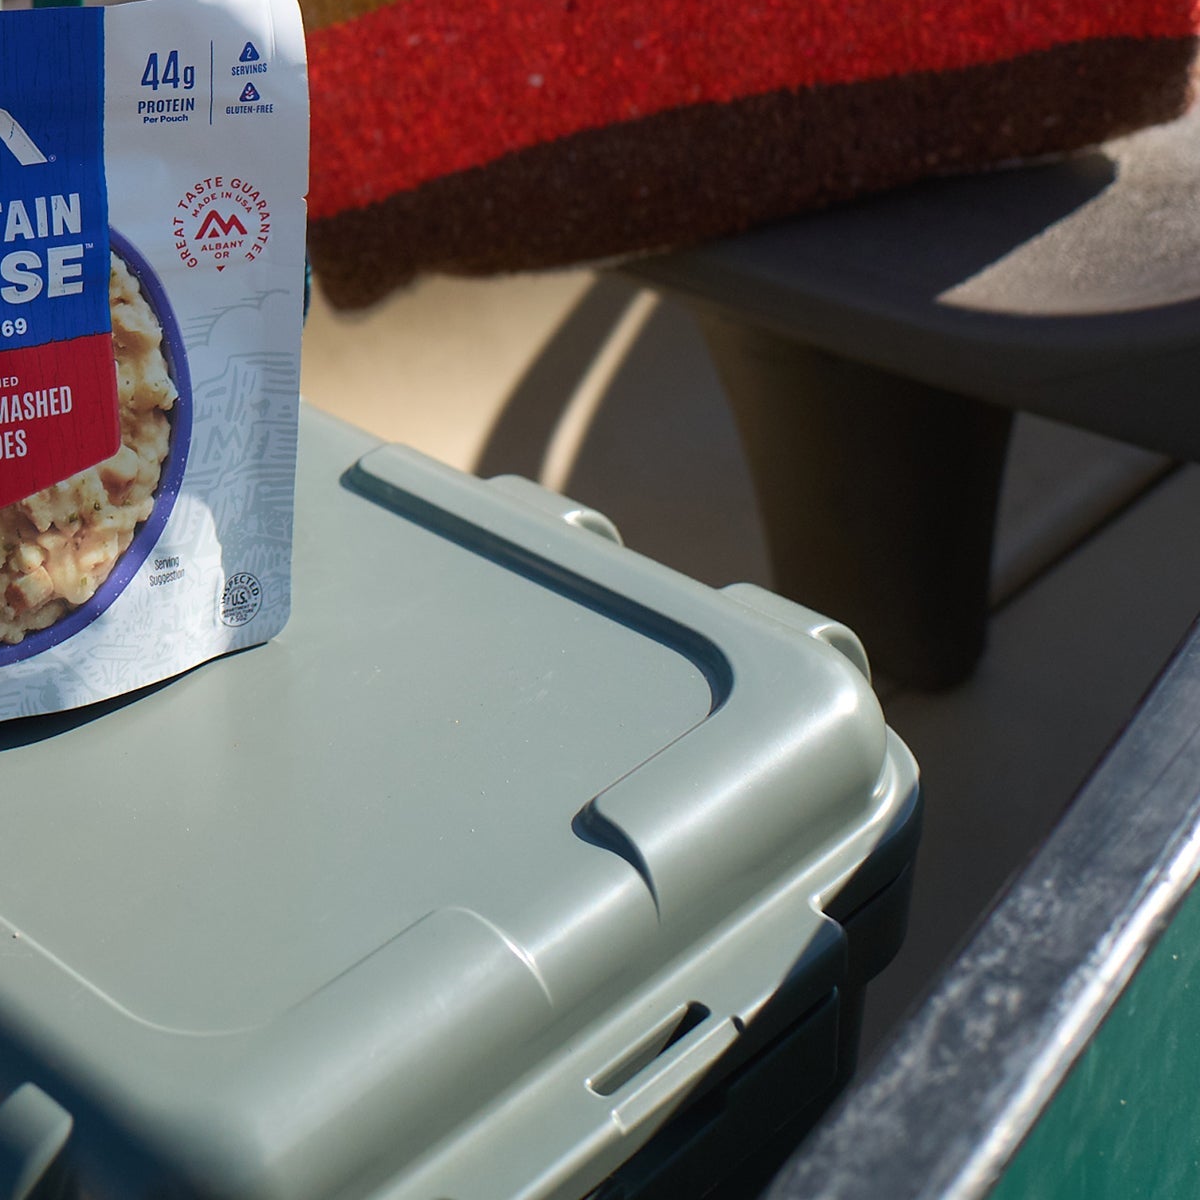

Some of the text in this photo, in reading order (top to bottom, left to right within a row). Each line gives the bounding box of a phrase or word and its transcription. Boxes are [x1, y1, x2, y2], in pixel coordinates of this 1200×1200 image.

[246, 47, 252, 59] 2
[140, 50, 195, 91] 44g
[231, 62, 267, 76] SERVINGS
[137, 98, 195, 115] PROTEIN
[225, 103, 273, 115] GLUTEN-FREE
[143, 113, 189, 124] Per Pouch
[192, 192, 218, 218] MADE
[235, 195, 252, 213] USA
[173, 176, 271, 269] GREAT TASTE GUARANTEE
[200, 239, 245, 252] ALBANY
[214, 251, 230, 259] OR
[154, 556, 180, 571] Serving
[149, 568, 185, 587] Suggestion
[231, 591, 248, 606] U.S.
